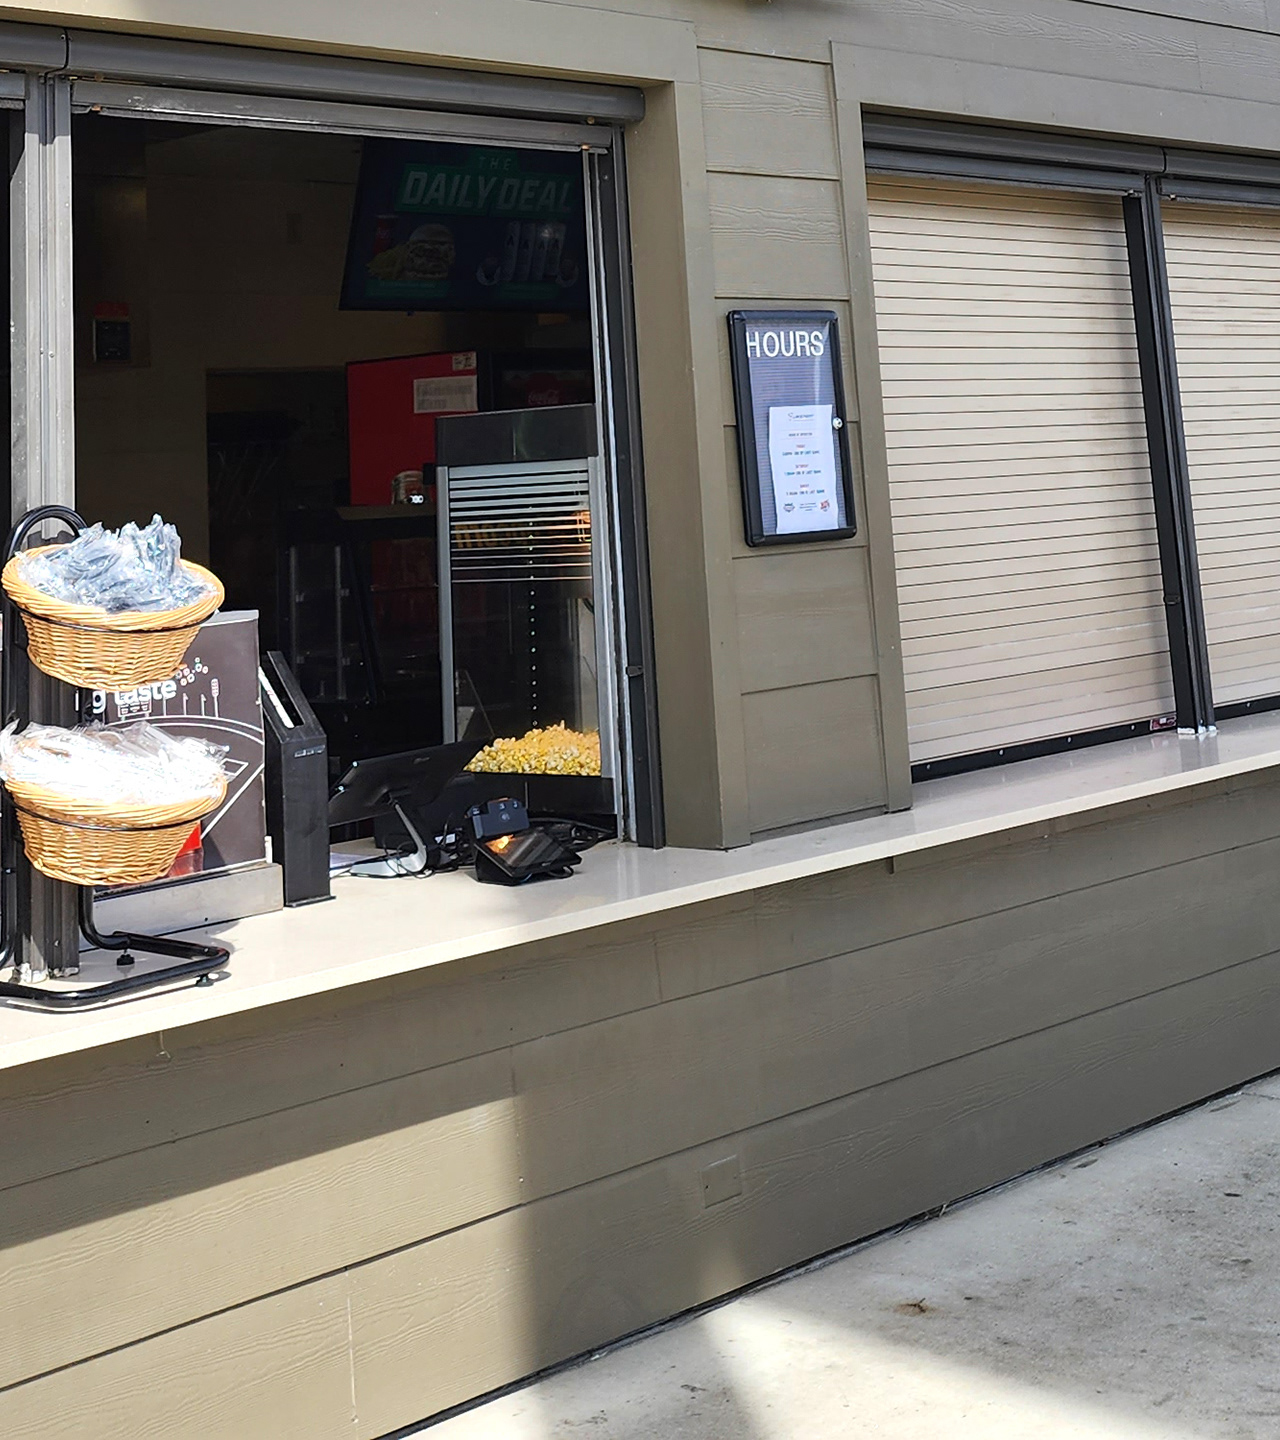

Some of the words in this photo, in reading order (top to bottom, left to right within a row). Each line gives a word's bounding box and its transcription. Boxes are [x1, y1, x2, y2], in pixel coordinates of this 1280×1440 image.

[478, 155, 513, 171] THE
[401, 170, 497, 209] DAILY
[495, 177, 573, 213] DEAL
[745, 330, 825, 359] HOURS
[114, 678, 178, 706] taste
